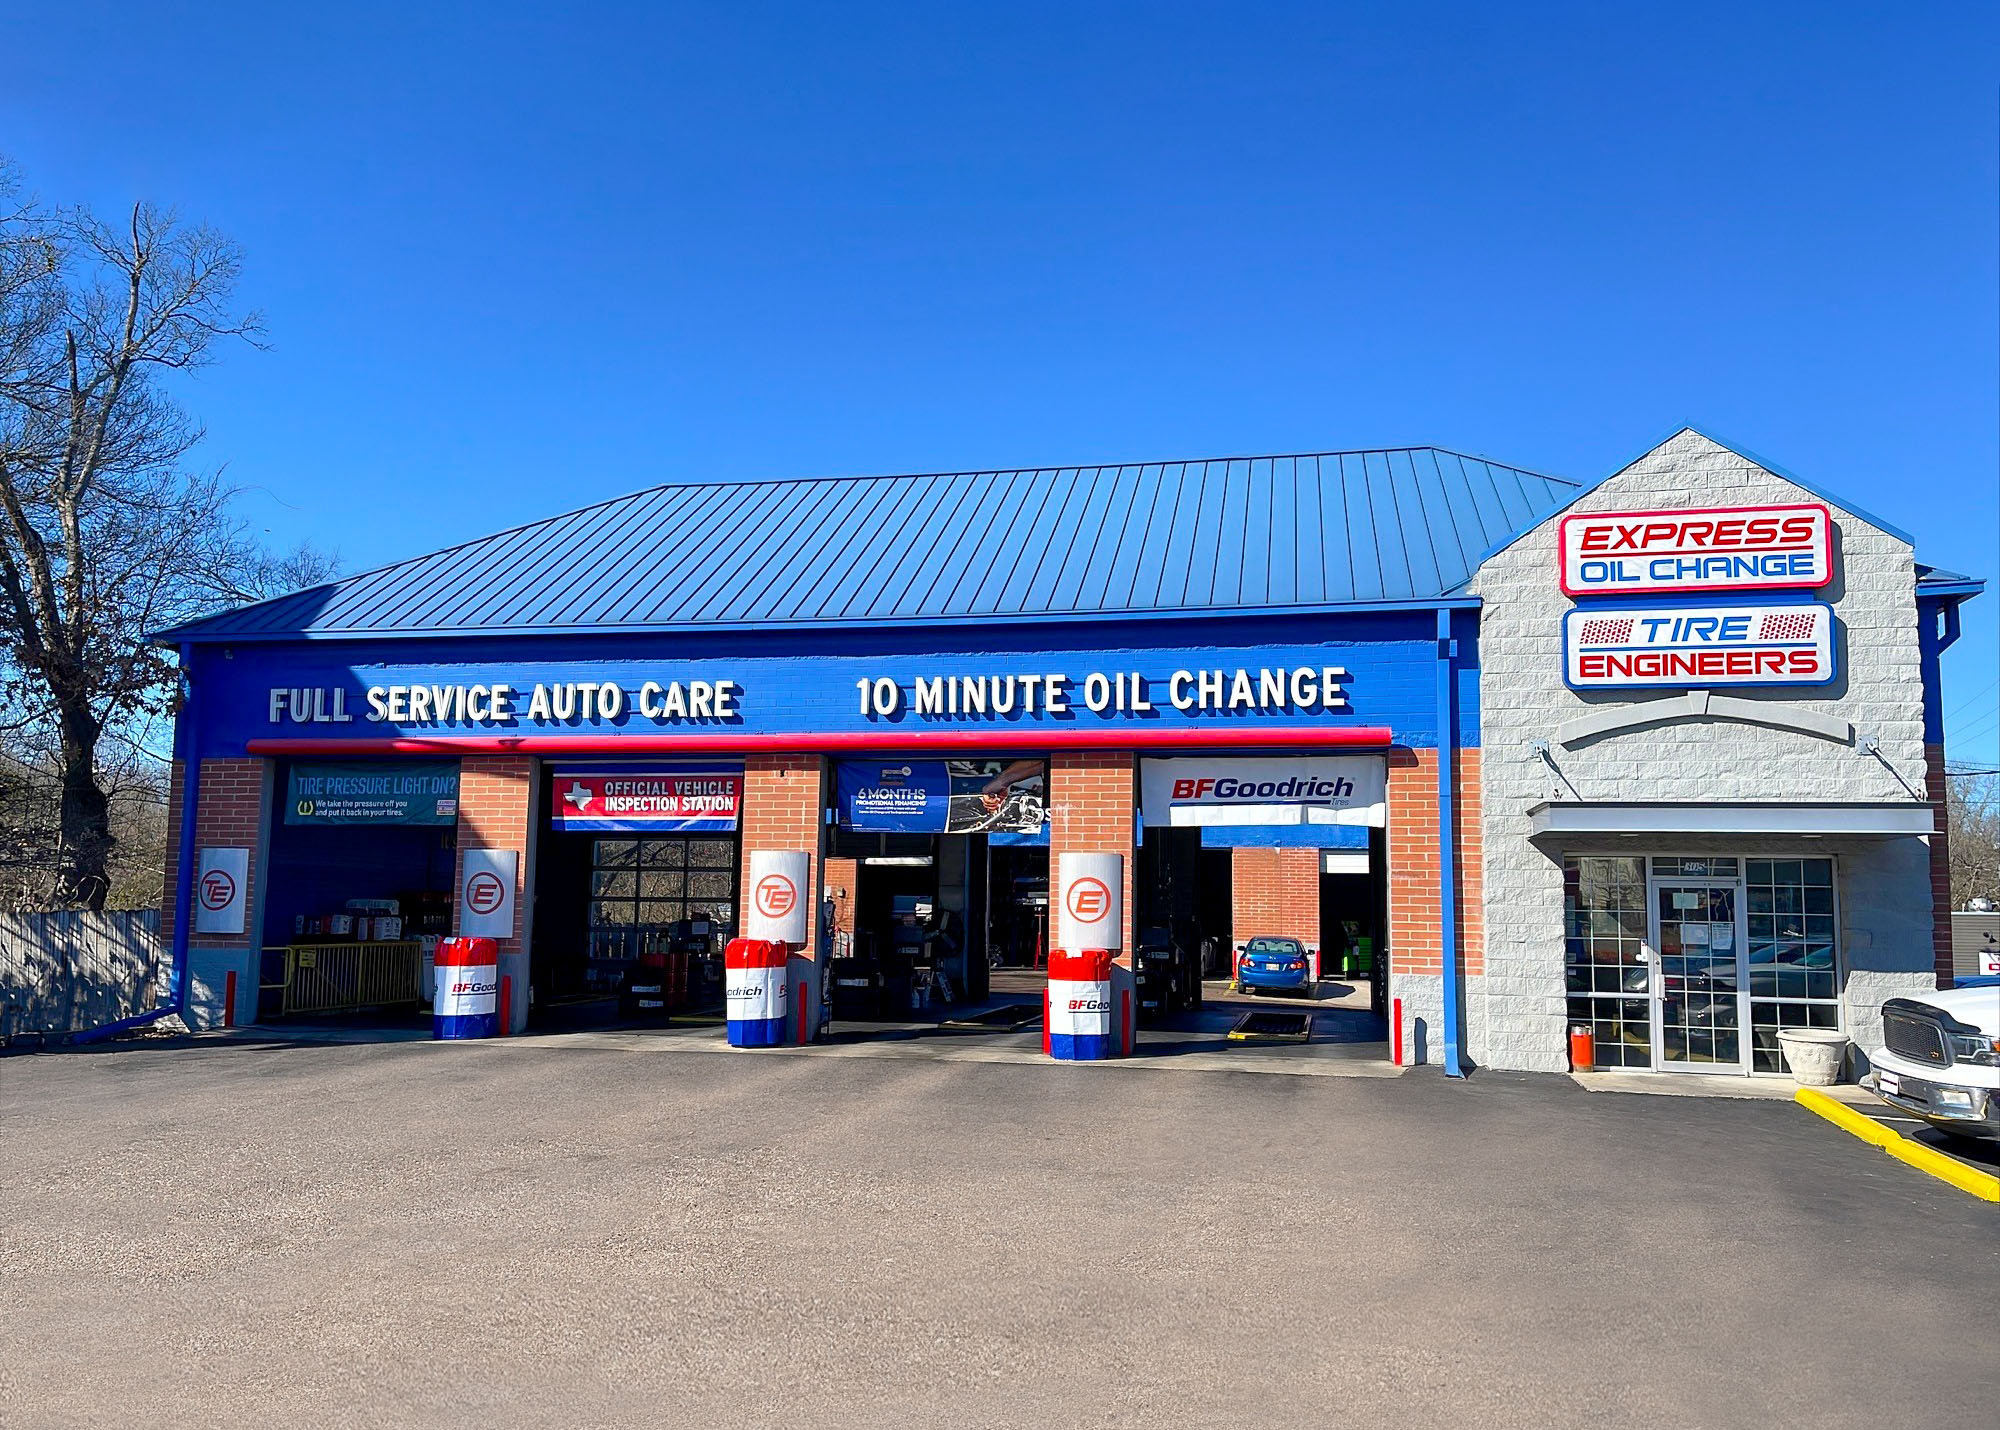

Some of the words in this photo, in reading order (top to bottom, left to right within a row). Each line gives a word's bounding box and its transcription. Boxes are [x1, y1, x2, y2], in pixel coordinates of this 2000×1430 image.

[1580, 516, 1815, 551] EXPRESS
[1580, 561, 1640, 583] OIL
[1650, 553, 1815, 581] CHANGE
[1641, 616, 1752, 643] TIRE
[1580, 650, 1818, 678] ENGINEERS
[269, 687, 352, 722] FULL
[366, 684, 512, 722] SERVICE
[527, 681, 622, 721] AUTO
[639, 680, 736, 719] CARE
[857, 676, 898, 715] 10
[915, 674, 1067, 715] MINUTE
[1084, 672, 1152, 713] OIL
[1169, 666, 1346, 711] CHANGE
[298, 777, 323, 795] TIRE
[326, 777, 391, 795] PRESSURE
[393, 777, 429, 795] LIGHT
[431, 776, 457, 794] ON?
[605, 781, 669, 795] OFFICIAL
[675, 781, 734, 795] VEHICLE
[858, 788, 866, 799] 6
[868, 788, 926, 800] MONTHS
[1172, 777, 1354, 799] BFGoodrich
[328, 809, 339, 817] put
[605, 797, 678, 811] INSPECTION
[682, 797, 734, 811] STATION
[1331, 798, 1349, 806] Tires
[204, 880, 230, 902] TE
[472, 884, 498, 904] E
[761, 885, 792, 909] TE
[1075, 891, 1103, 913] E
